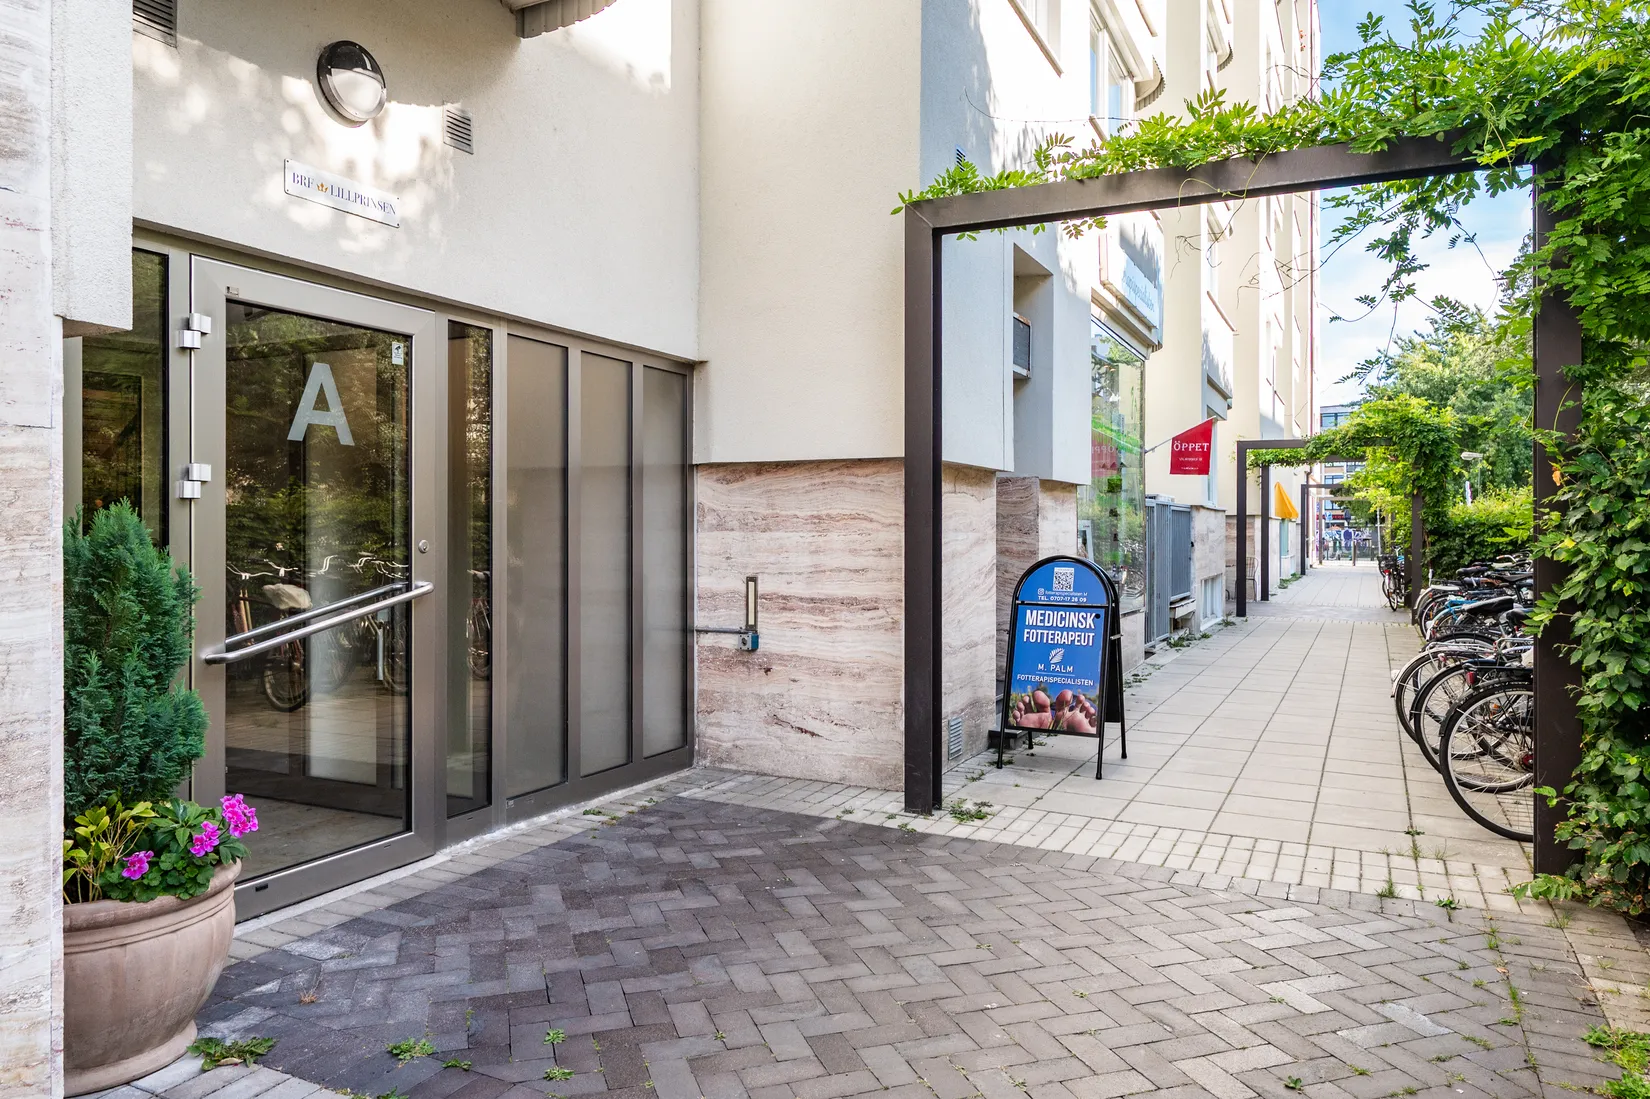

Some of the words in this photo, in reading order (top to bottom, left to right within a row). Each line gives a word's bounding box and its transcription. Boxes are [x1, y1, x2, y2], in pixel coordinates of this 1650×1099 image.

[292, 172, 315, 188] BRF
[330, 184, 396, 215] LILLPRINSEN
[287, 361, 355, 446] A
[1173, 440, 1209, 452] ÖPPET
[1025, 609, 1096, 629] MEDICINSK
[1023, 629, 1095, 646] FOTTERAPEUT
[1037, 663, 1047, 671] M.
[1050, 664, 1073, 673] PALM
[1016, 674, 1094, 686] FOTTERAPISPECIALISTEN
